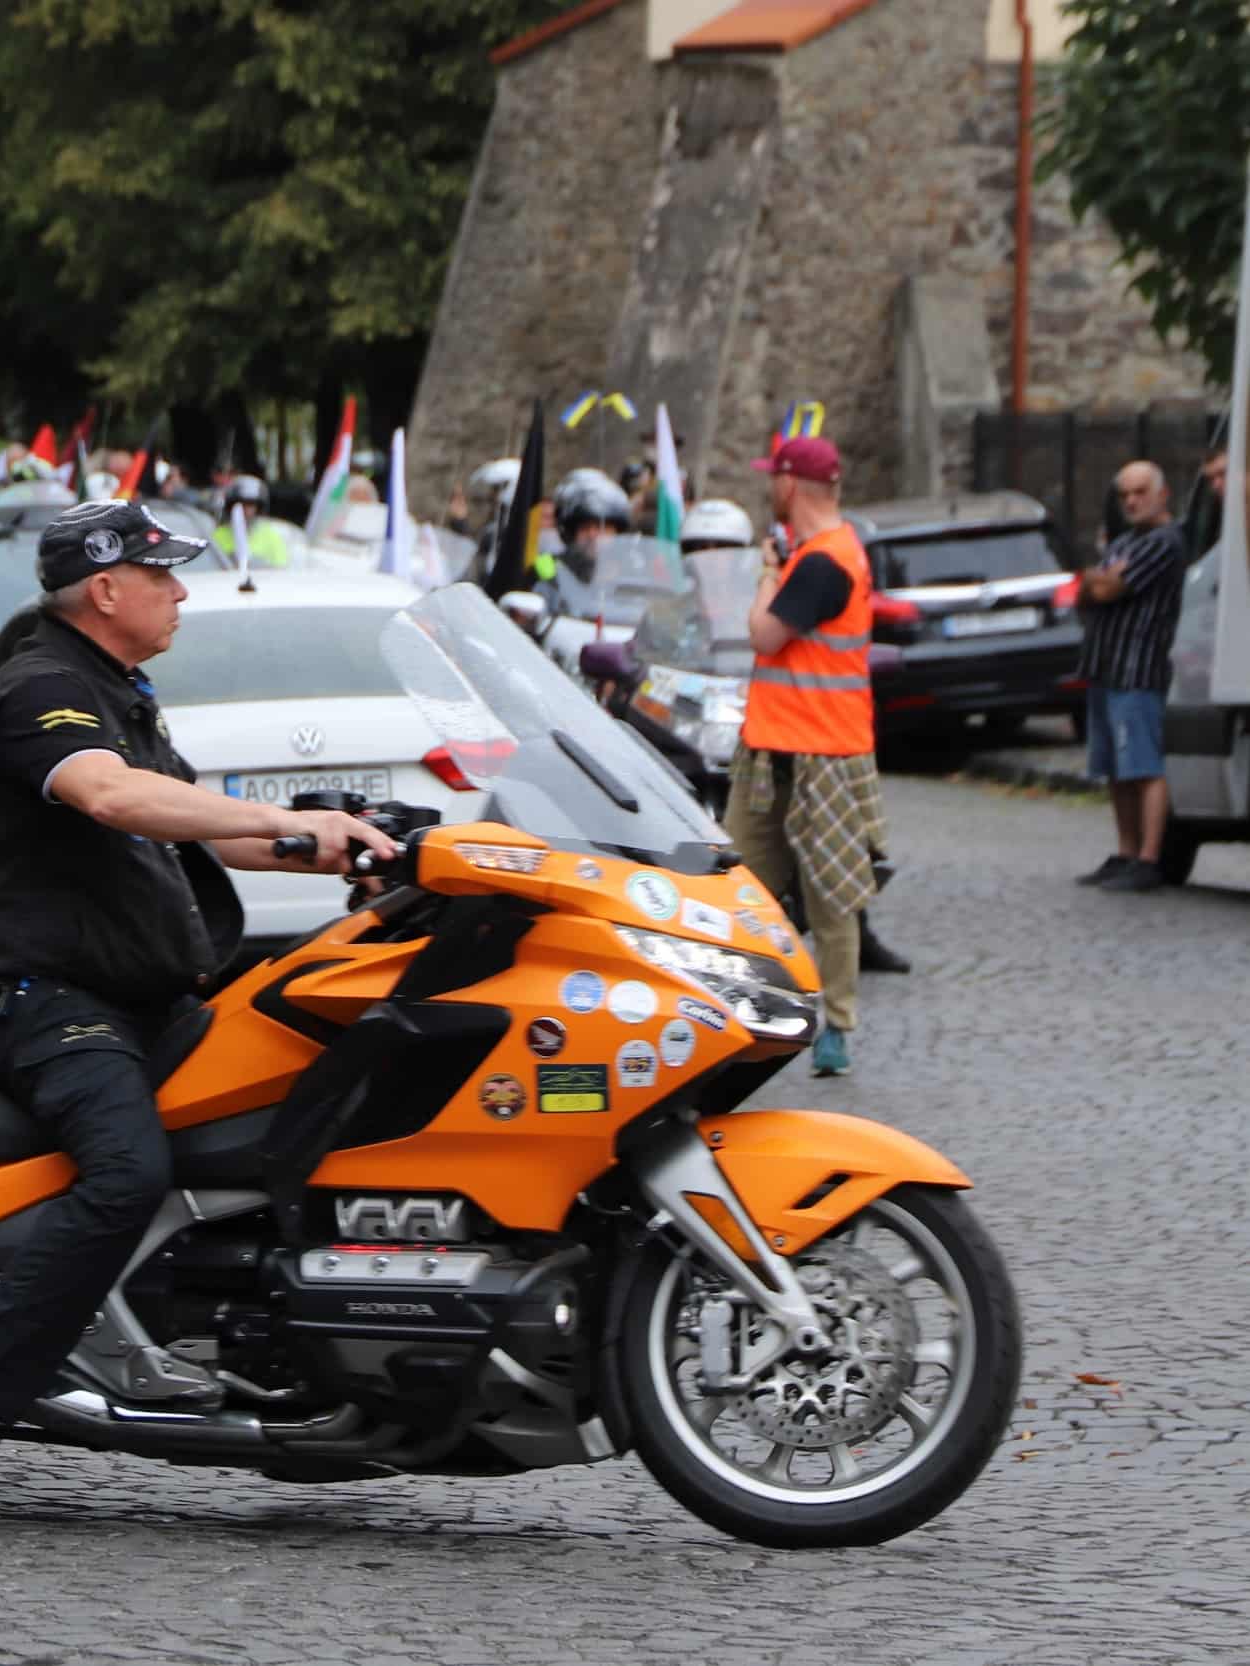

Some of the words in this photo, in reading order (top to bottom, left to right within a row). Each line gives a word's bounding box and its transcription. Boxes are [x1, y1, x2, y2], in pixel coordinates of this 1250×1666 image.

[246, 779, 278, 803] AO
[350, 773, 386, 798] HE
[345, 1302, 437, 1316] HONDA
